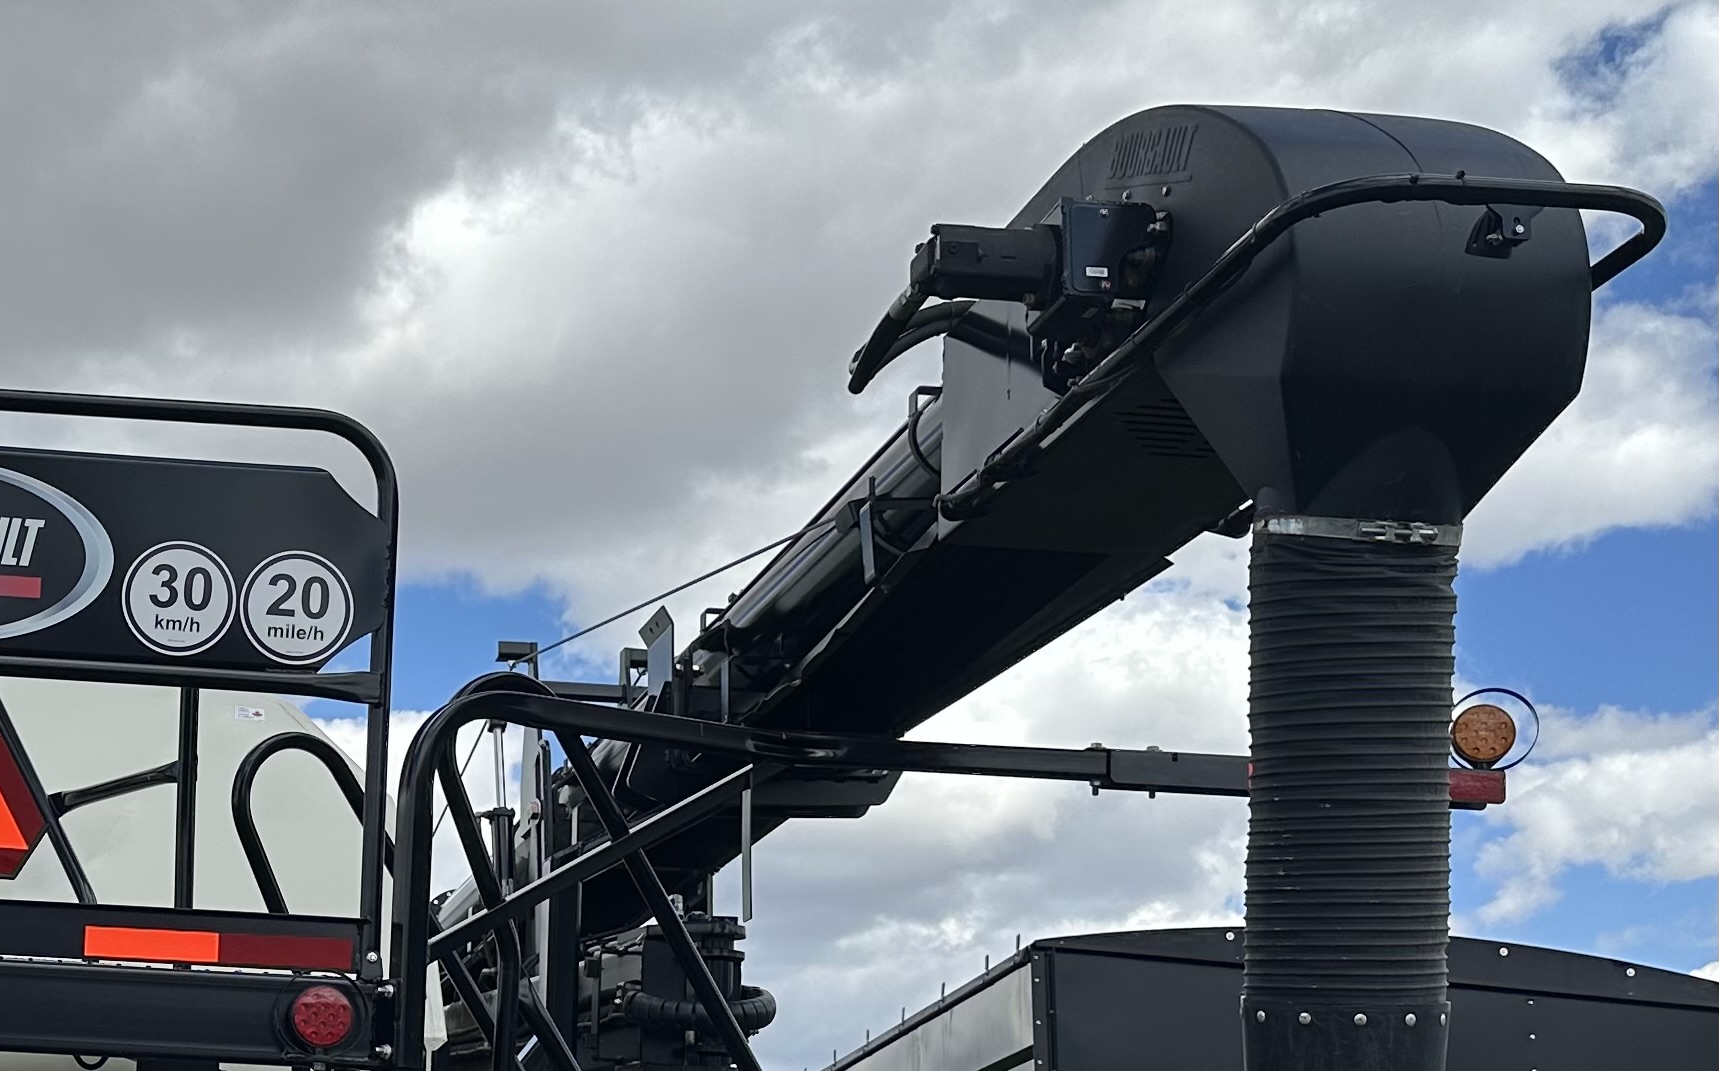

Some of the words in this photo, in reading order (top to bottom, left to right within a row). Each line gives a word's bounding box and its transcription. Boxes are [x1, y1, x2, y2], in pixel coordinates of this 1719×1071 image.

[148, 563, 213, 612] 30
[265, 573, 330, 620] 20
[154, 614, 200, 633] km/h
[267, 624, 324, 641] mile/h
